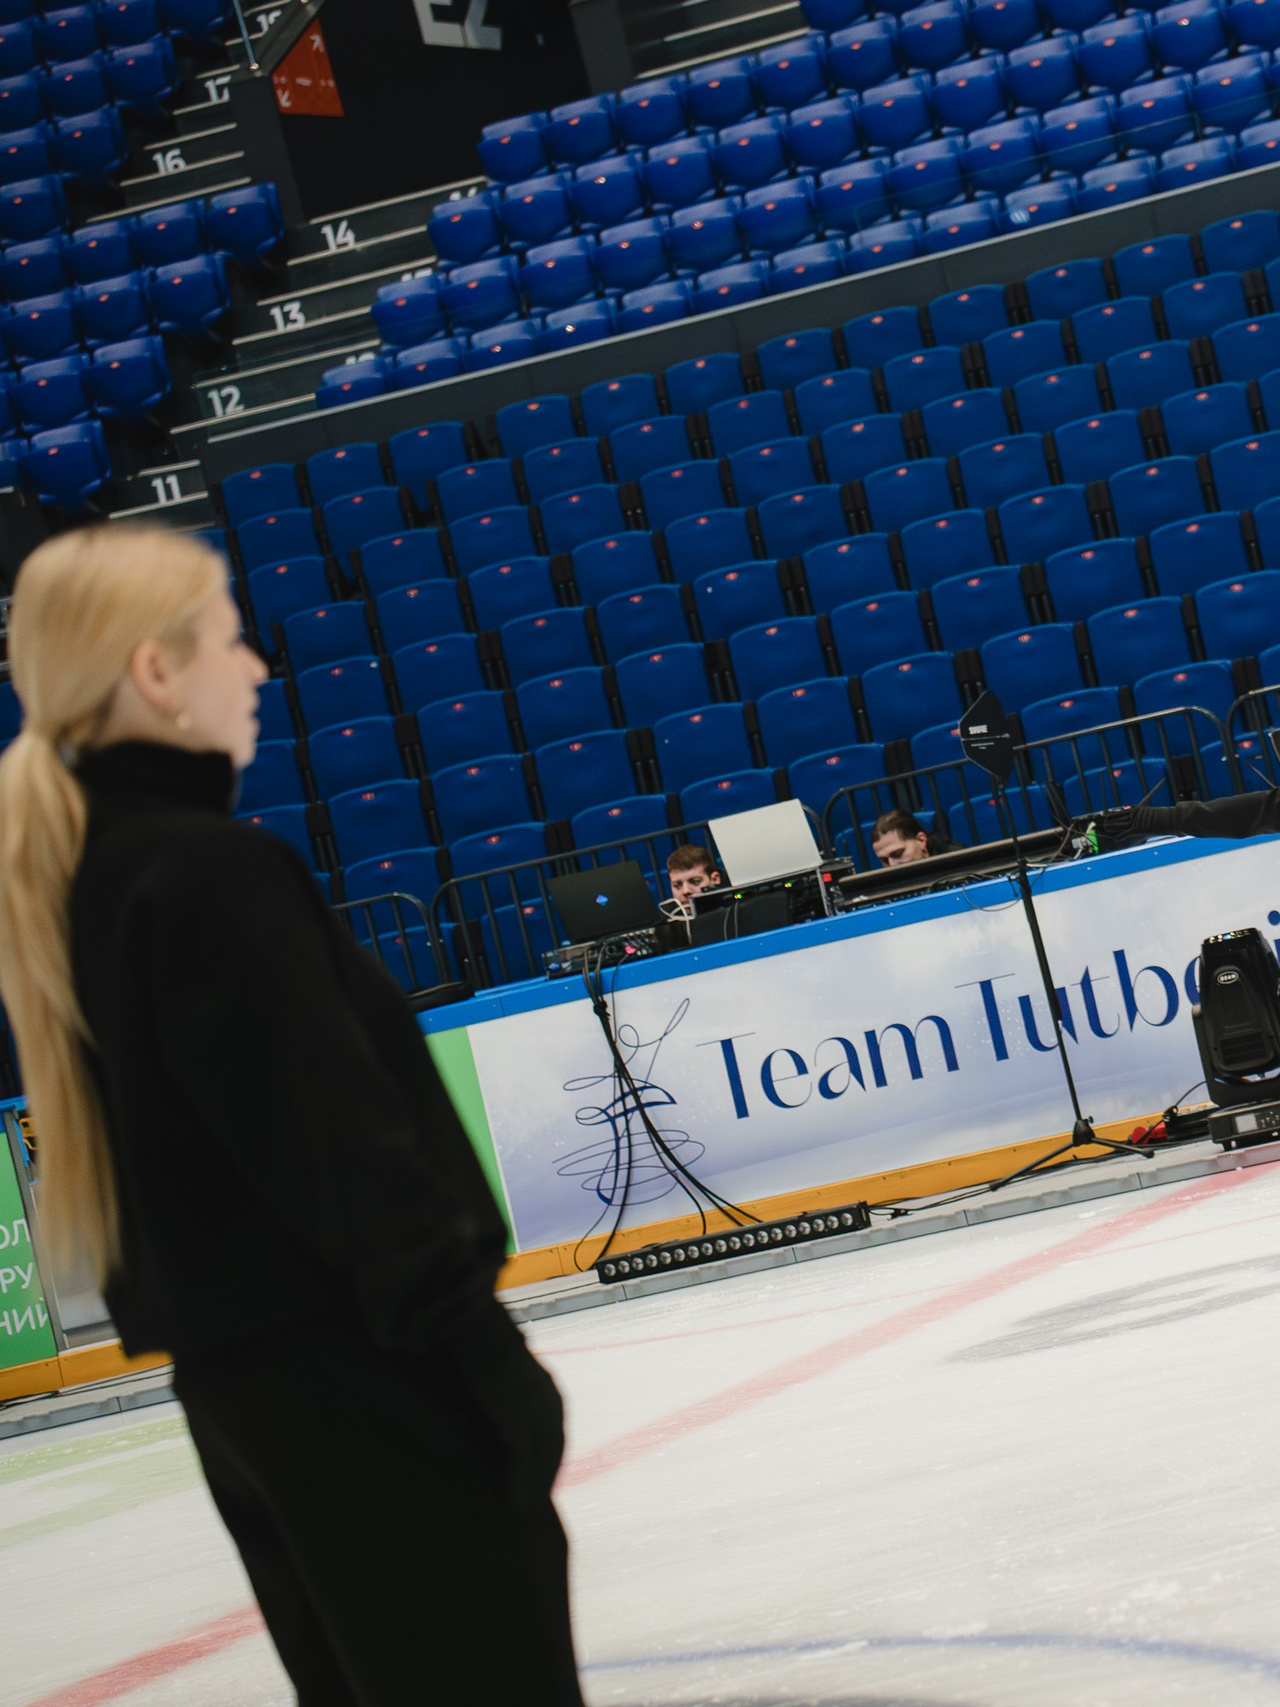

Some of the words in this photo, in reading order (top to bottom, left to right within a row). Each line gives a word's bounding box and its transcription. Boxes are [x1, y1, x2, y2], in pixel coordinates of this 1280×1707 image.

[204, 75, 232, 104] 17
[152, 148, 187, 175] 16
[320, 219, 357, 251] 14
[269, 300, 306, 332] 13
[207, 385, 245, 418] 12
[151, 474, 182, 504] 11
[696, 1014, 960, 1120] Team
